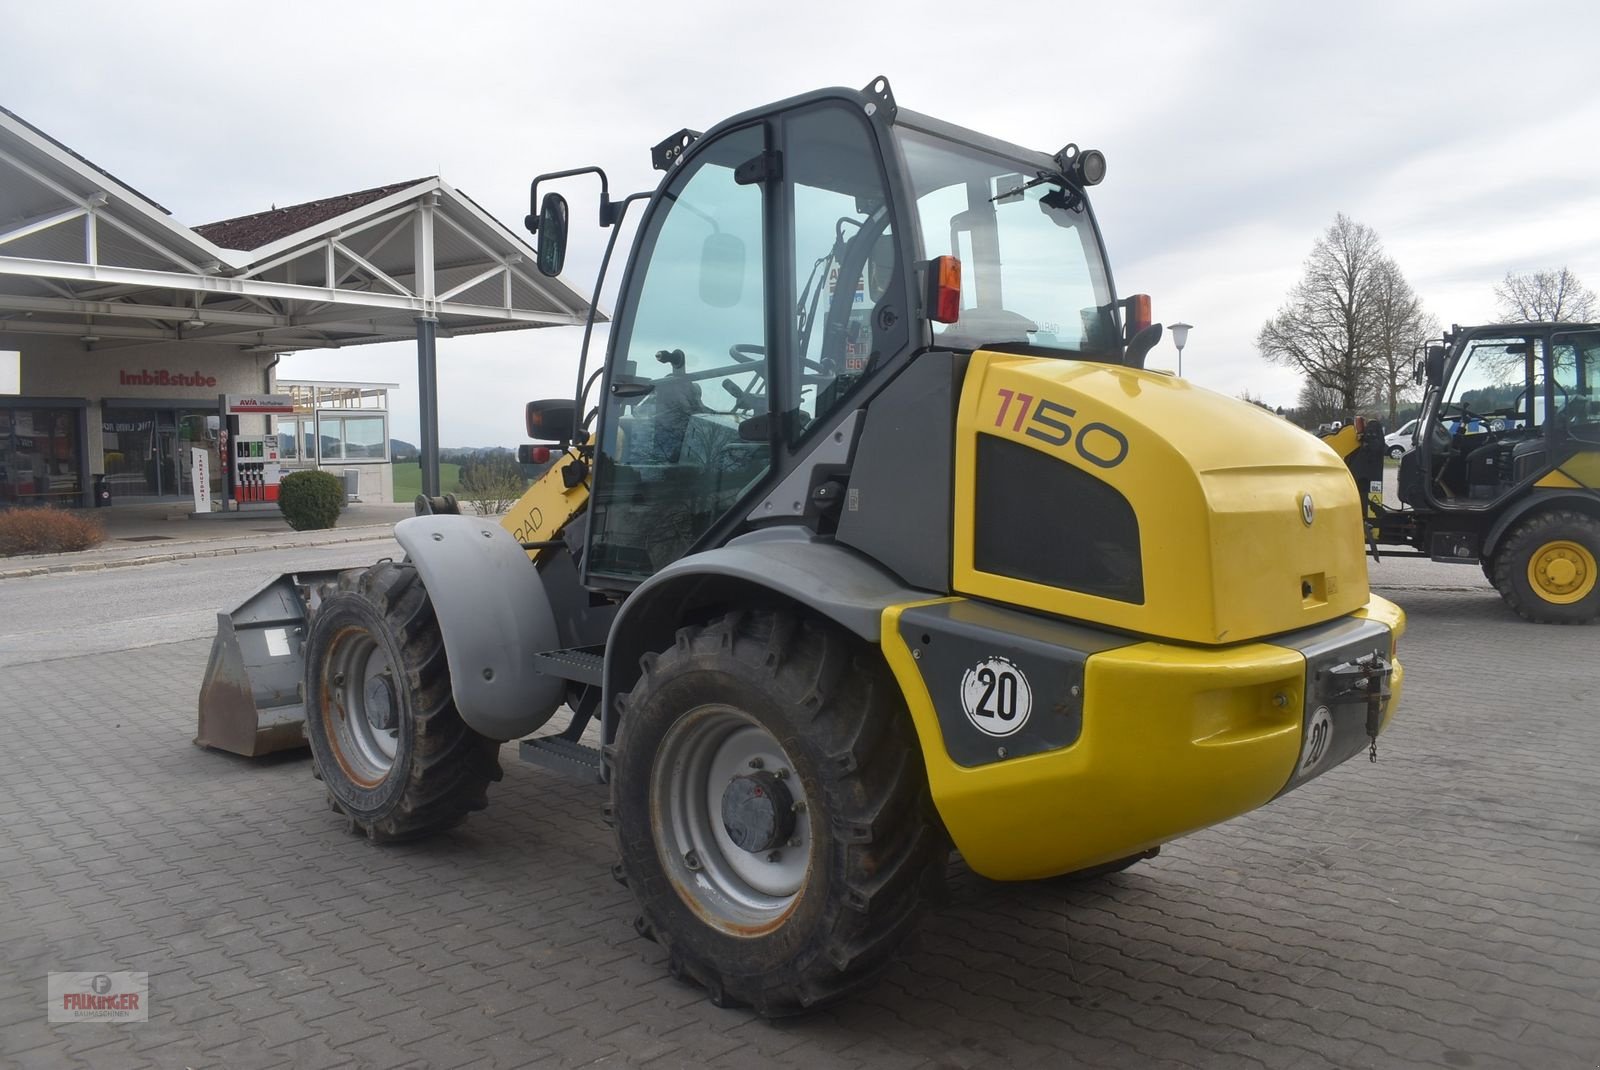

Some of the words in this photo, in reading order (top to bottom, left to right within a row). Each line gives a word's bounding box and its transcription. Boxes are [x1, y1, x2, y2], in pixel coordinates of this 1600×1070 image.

[120, 369, 217, 387] Imbißstube
[239, 398, 258, 406] AVIA
[994, 388, 1129, 469] 1150
[975, 668, 1018, 721] 20
[1304, 718, 1329, 765] 20
